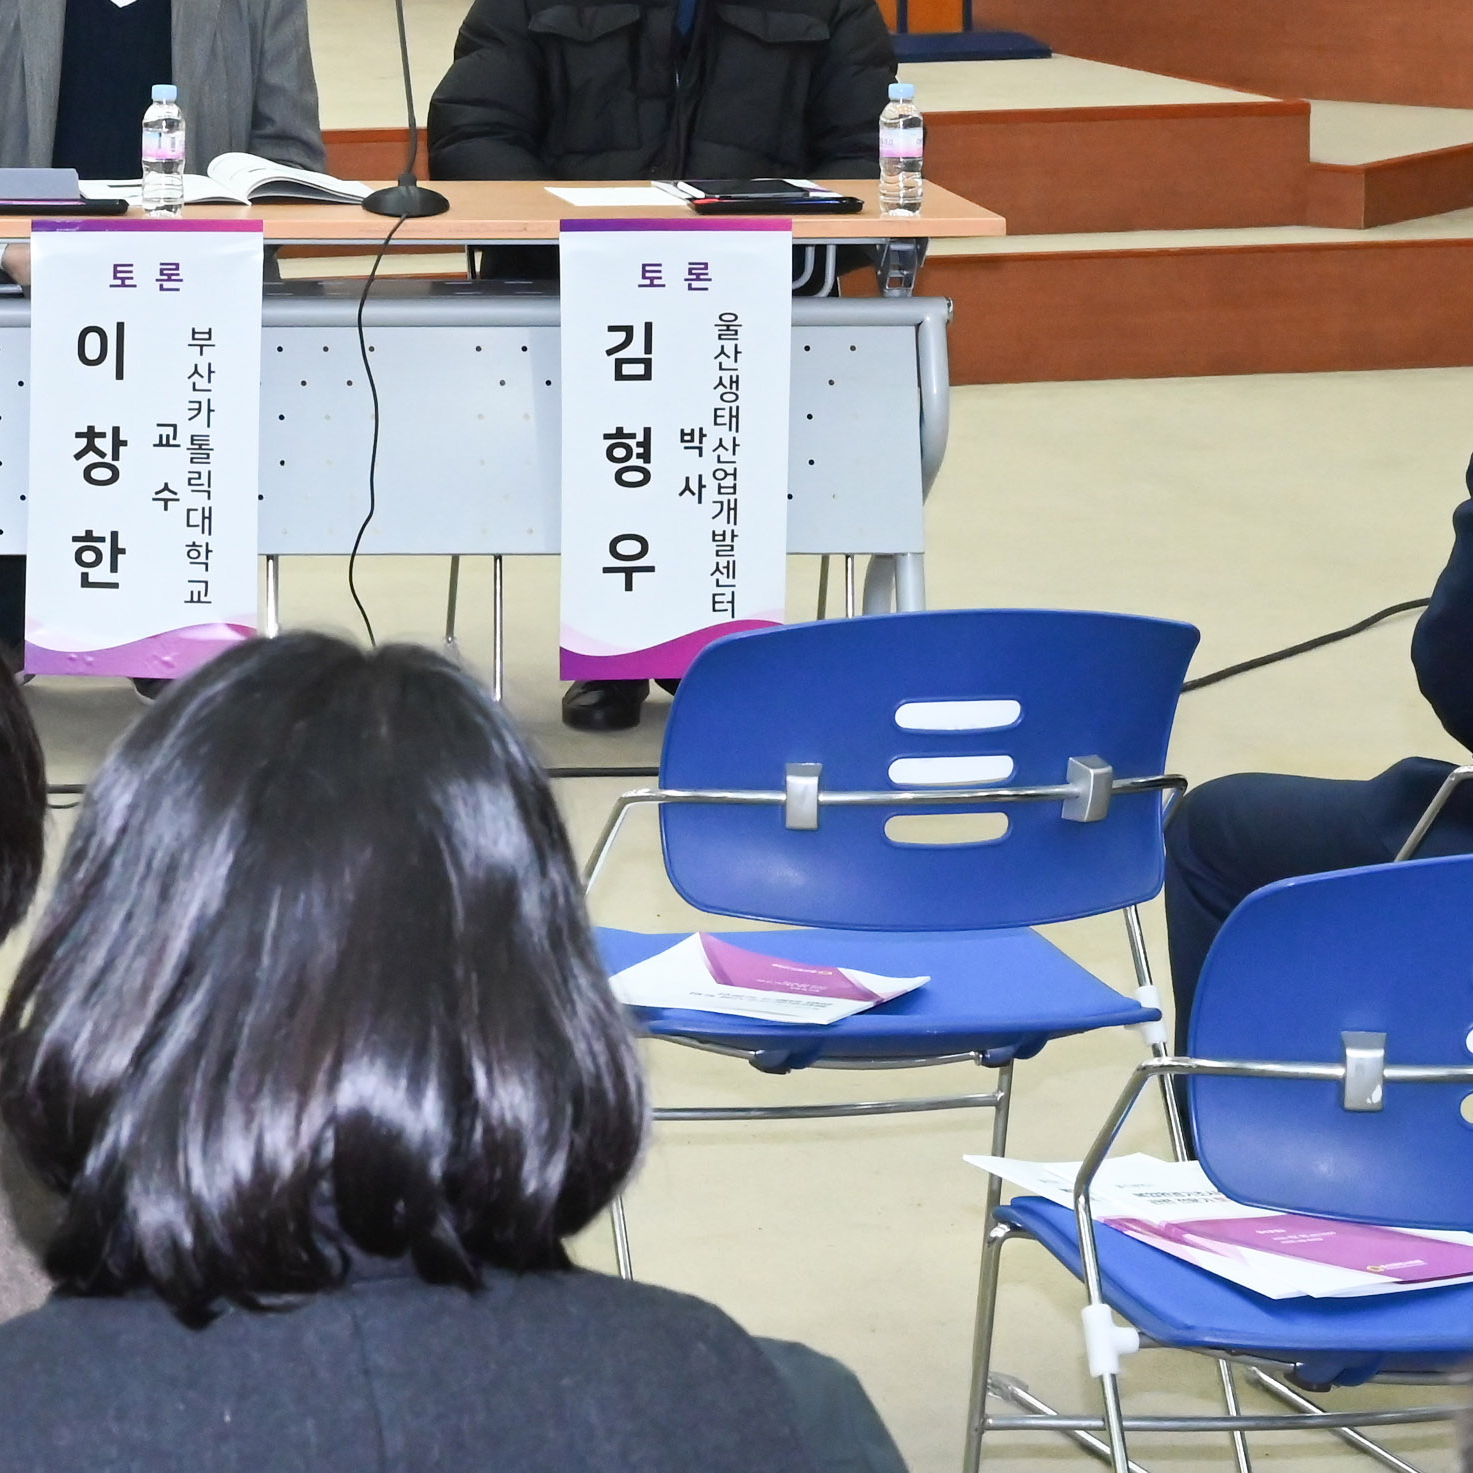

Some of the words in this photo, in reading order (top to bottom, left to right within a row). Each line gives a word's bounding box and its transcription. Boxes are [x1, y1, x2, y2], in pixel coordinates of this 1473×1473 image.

[71, 322, 128, 589] 이창한
[152, 424, 180, 511] 교수
[184, 327, 215, 604] 부산카톨릭대학교
[603, 322, 655, 591] 김형우
[679, 427, 707, 504] 박사
[710, 312, 742, 618] 울산생태산업개발센터
